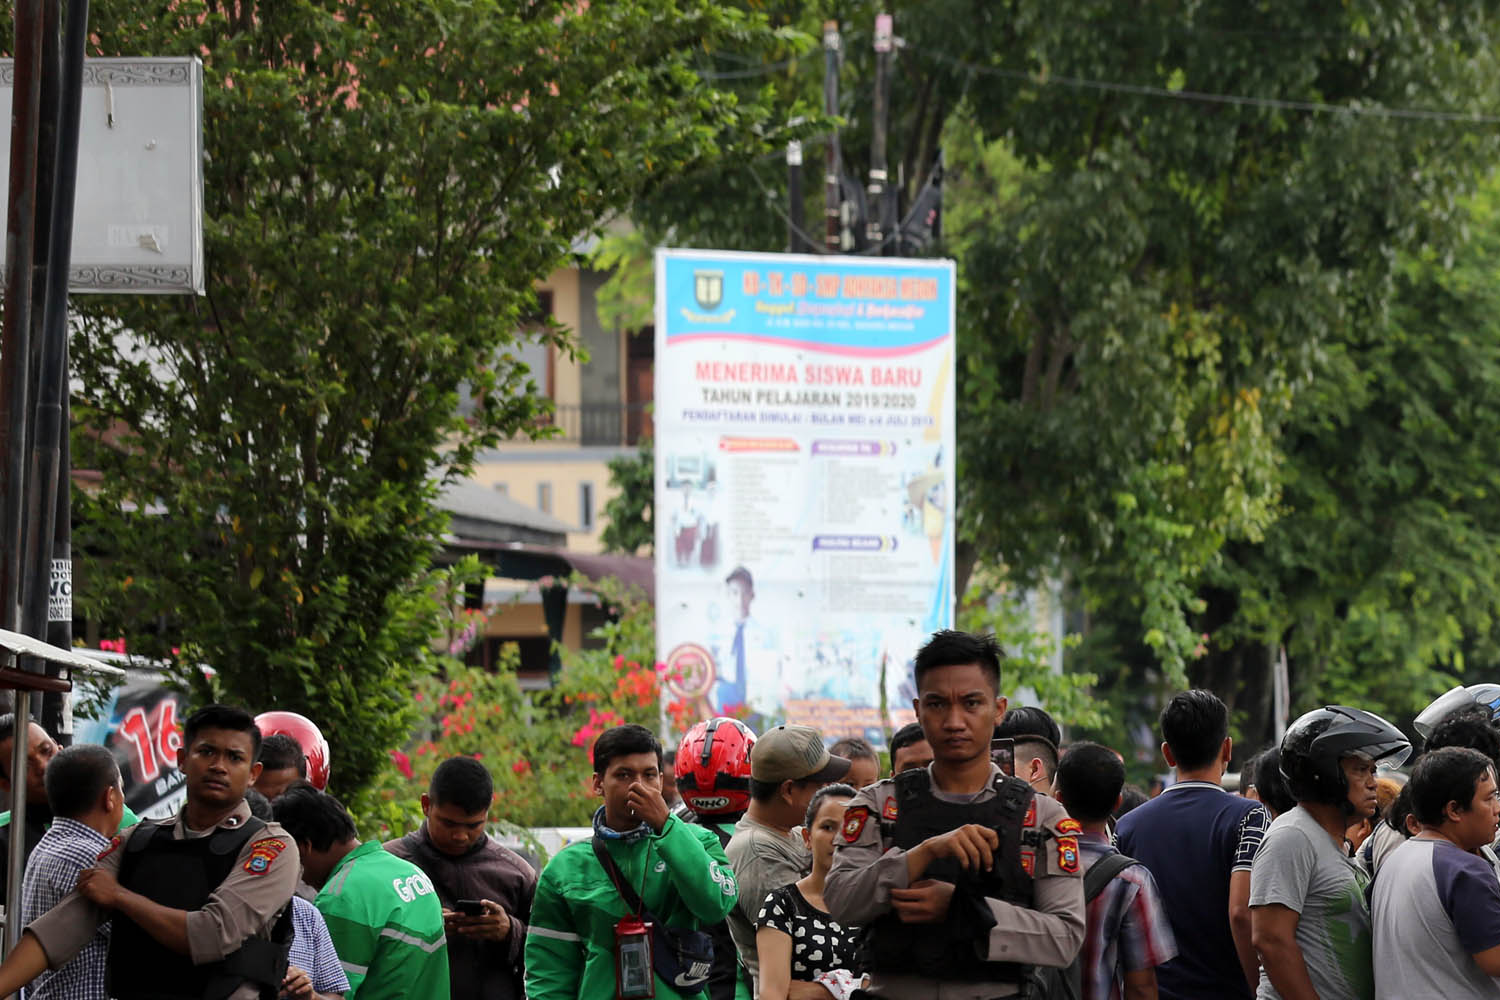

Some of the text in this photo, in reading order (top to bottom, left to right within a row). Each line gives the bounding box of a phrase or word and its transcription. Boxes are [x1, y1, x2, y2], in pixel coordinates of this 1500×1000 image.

[696, 361, 923, 388] MENERIMA SISWA BARU
[701, 388, 752, 405] TAHUN
[756, 389, 841, 408] PELAJARAN
